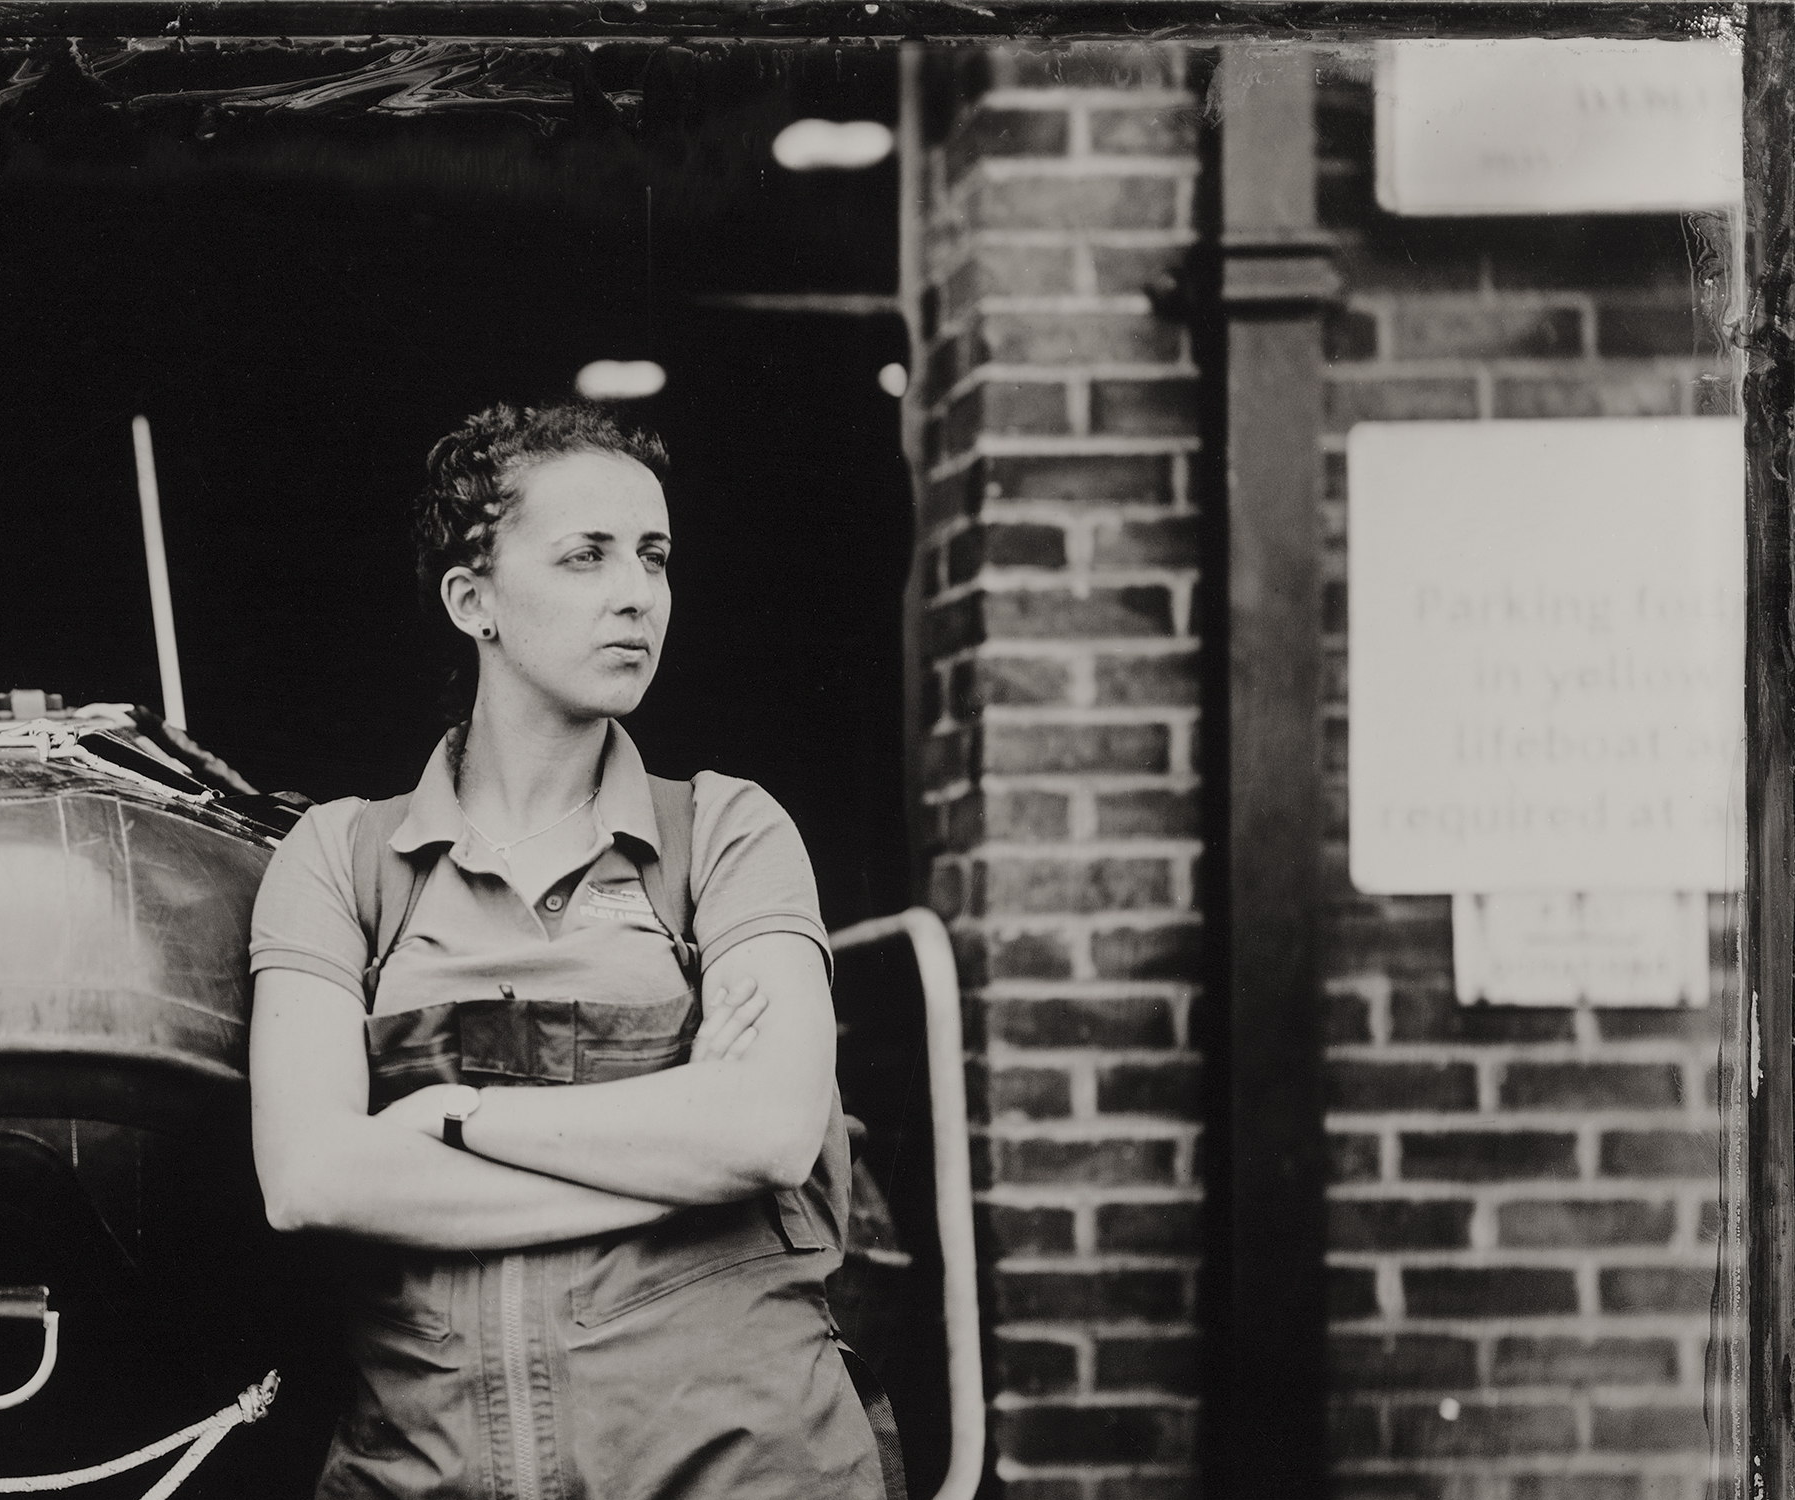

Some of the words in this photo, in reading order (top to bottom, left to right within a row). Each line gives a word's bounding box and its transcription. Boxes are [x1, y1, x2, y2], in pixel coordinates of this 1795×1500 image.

[1412, 579, 1614, 634] Parking
[1473, 646, 1523, 692] in
[1454, 723, 1661, 764] lifeboat
[1380, 794, 1608, 846] required
